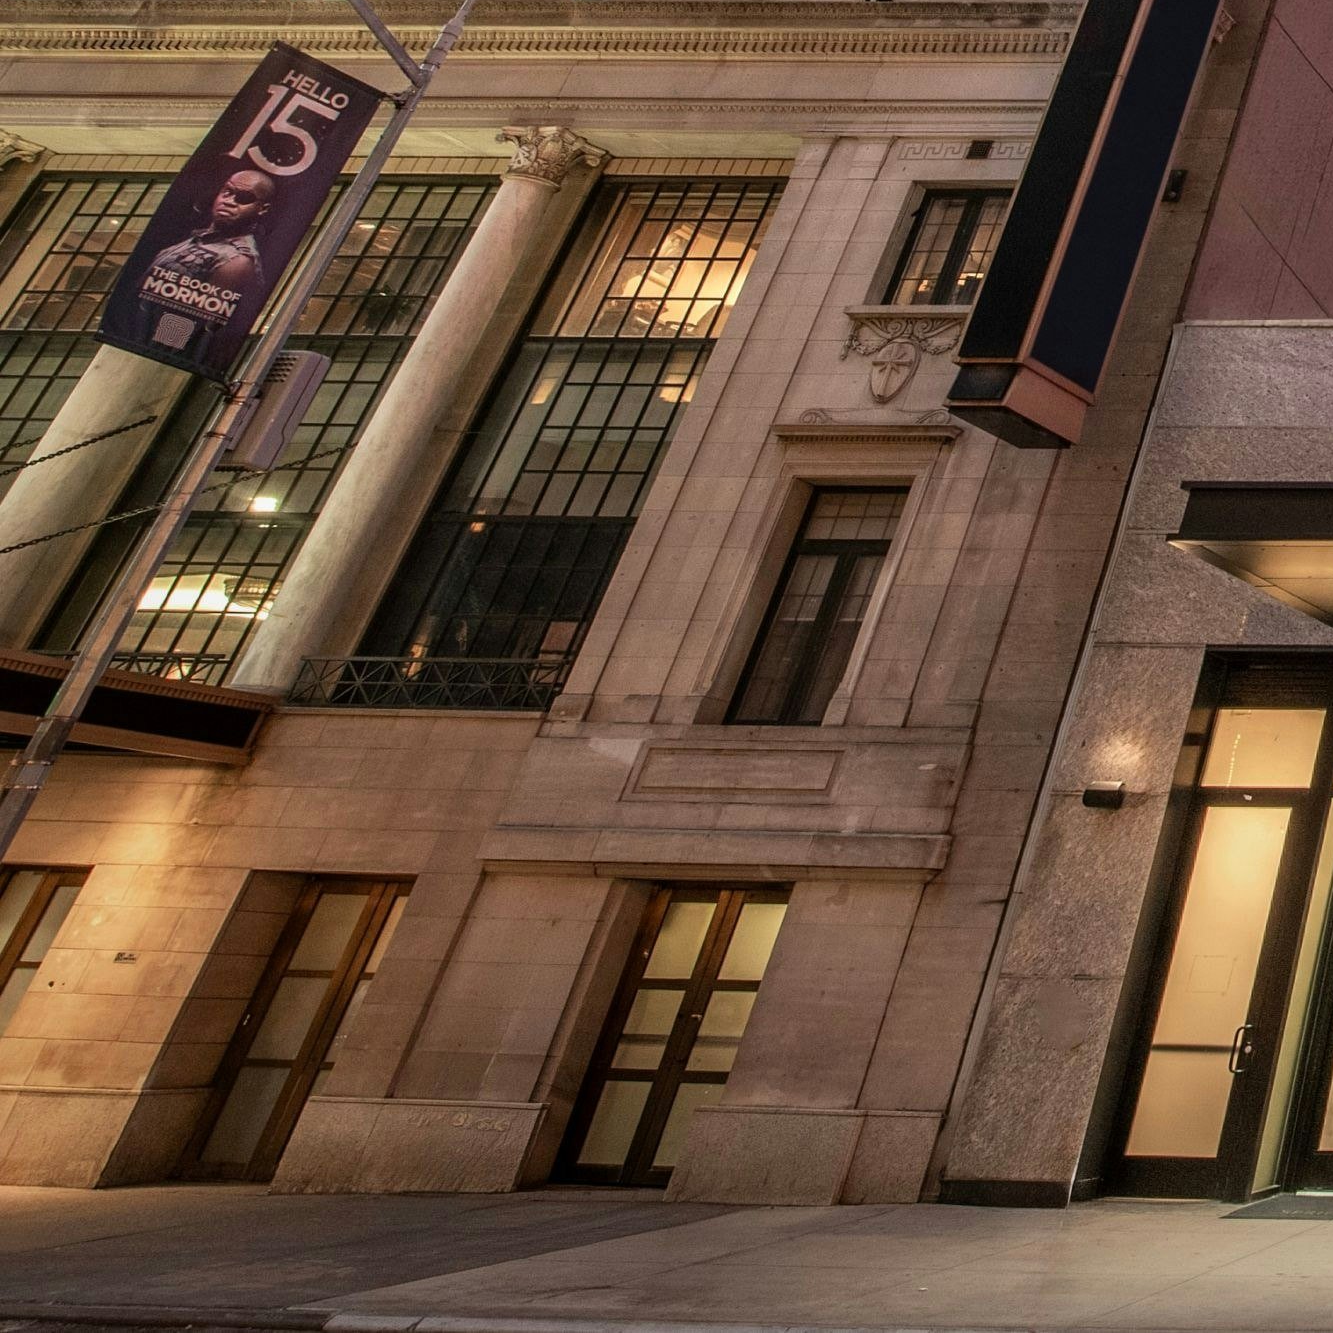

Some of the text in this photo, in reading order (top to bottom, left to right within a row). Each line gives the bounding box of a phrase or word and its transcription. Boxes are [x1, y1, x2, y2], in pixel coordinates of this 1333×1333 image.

[281, 69, 349, 109] HELLO
[229, 84, 340, 176] 15
[142, 276, 237, 318] MORMON
[152, 266, 242, 302] THE BOOK OF
